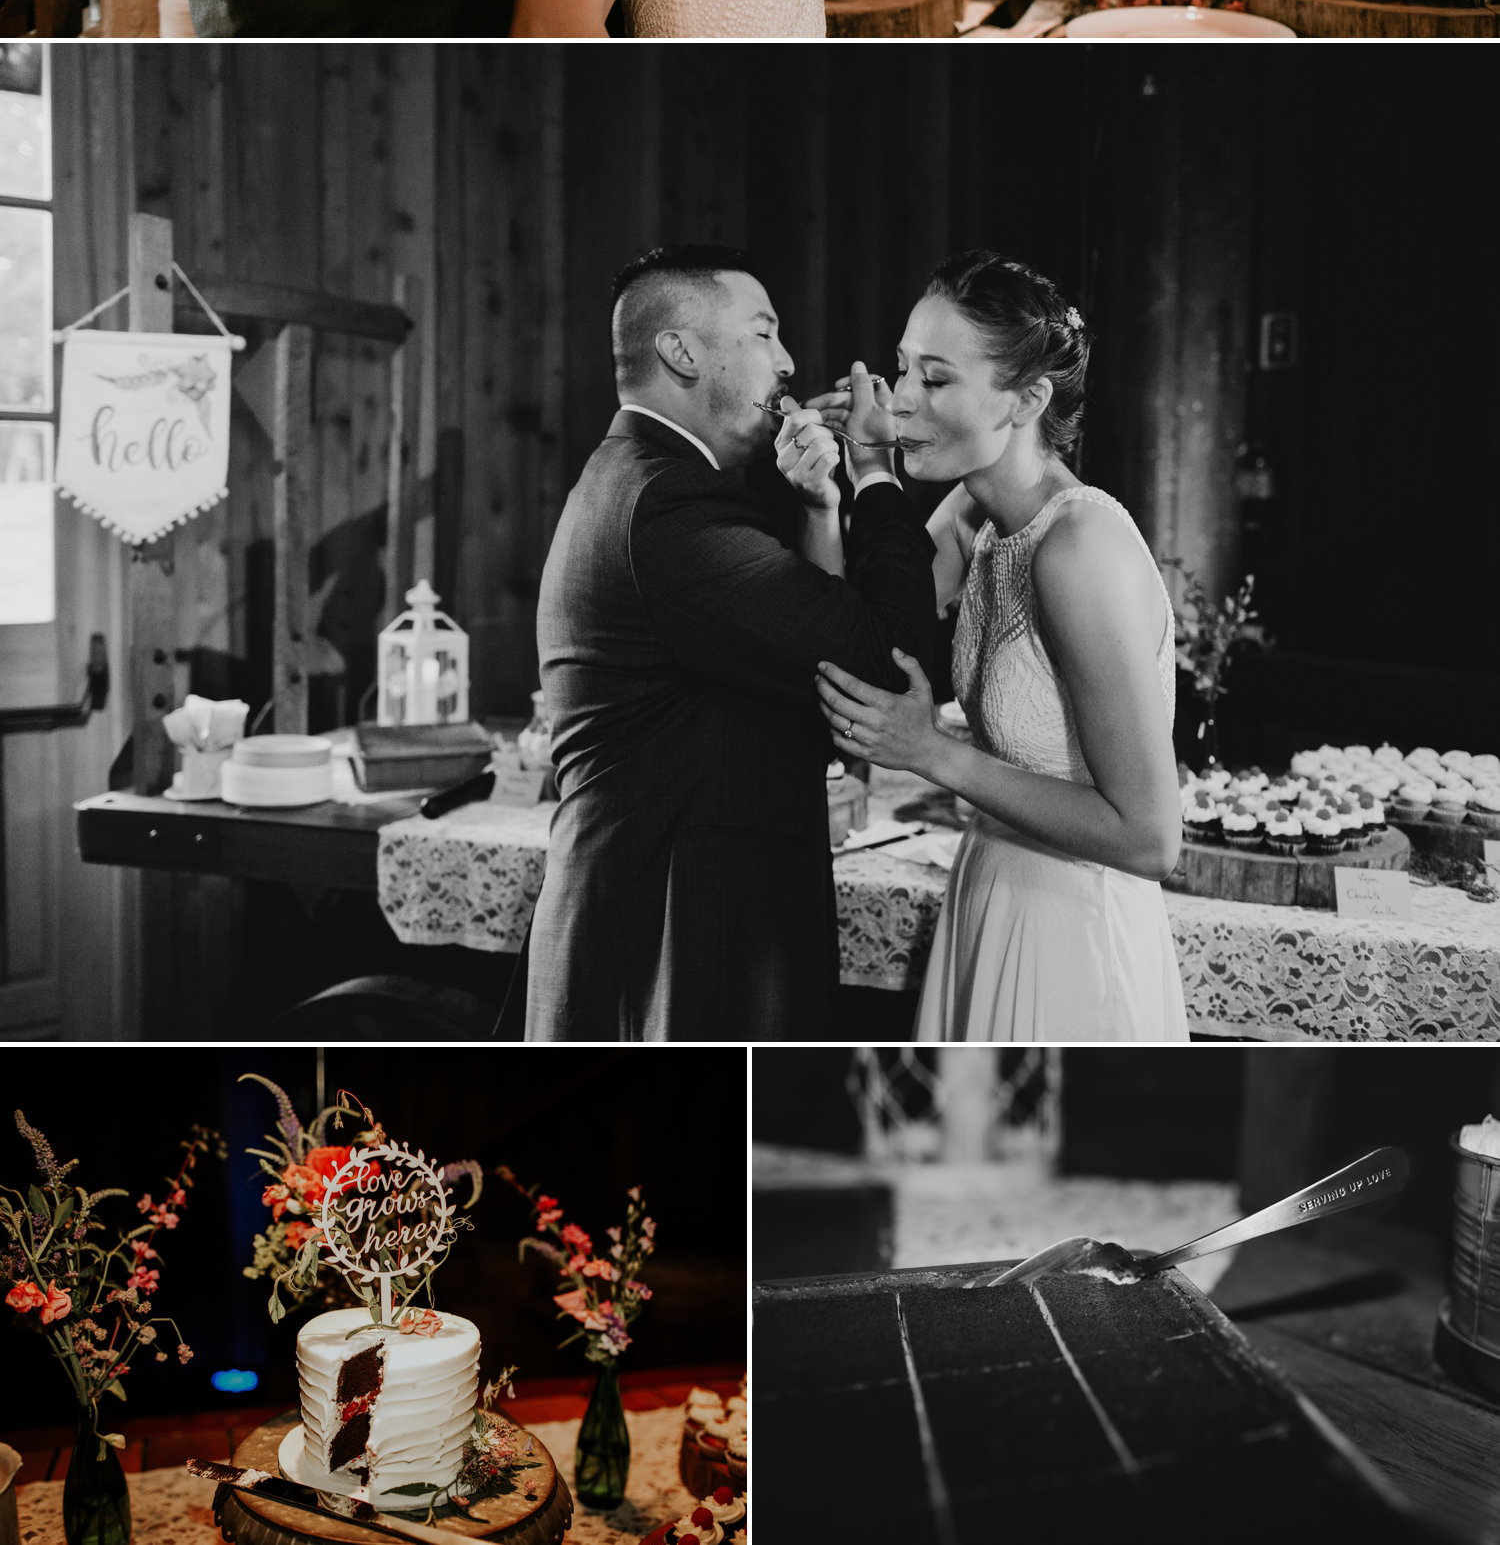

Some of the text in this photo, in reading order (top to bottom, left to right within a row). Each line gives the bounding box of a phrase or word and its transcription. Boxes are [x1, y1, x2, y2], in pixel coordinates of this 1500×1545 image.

[76, 404, 208, 473] hello
[340, 1162, 424, 1196] love
[1299, 1168, 1392, 1213] SERVING UP LOVE
[332, 1190, 435, 1234] grows
[346, 1220, 437, 1257] here
